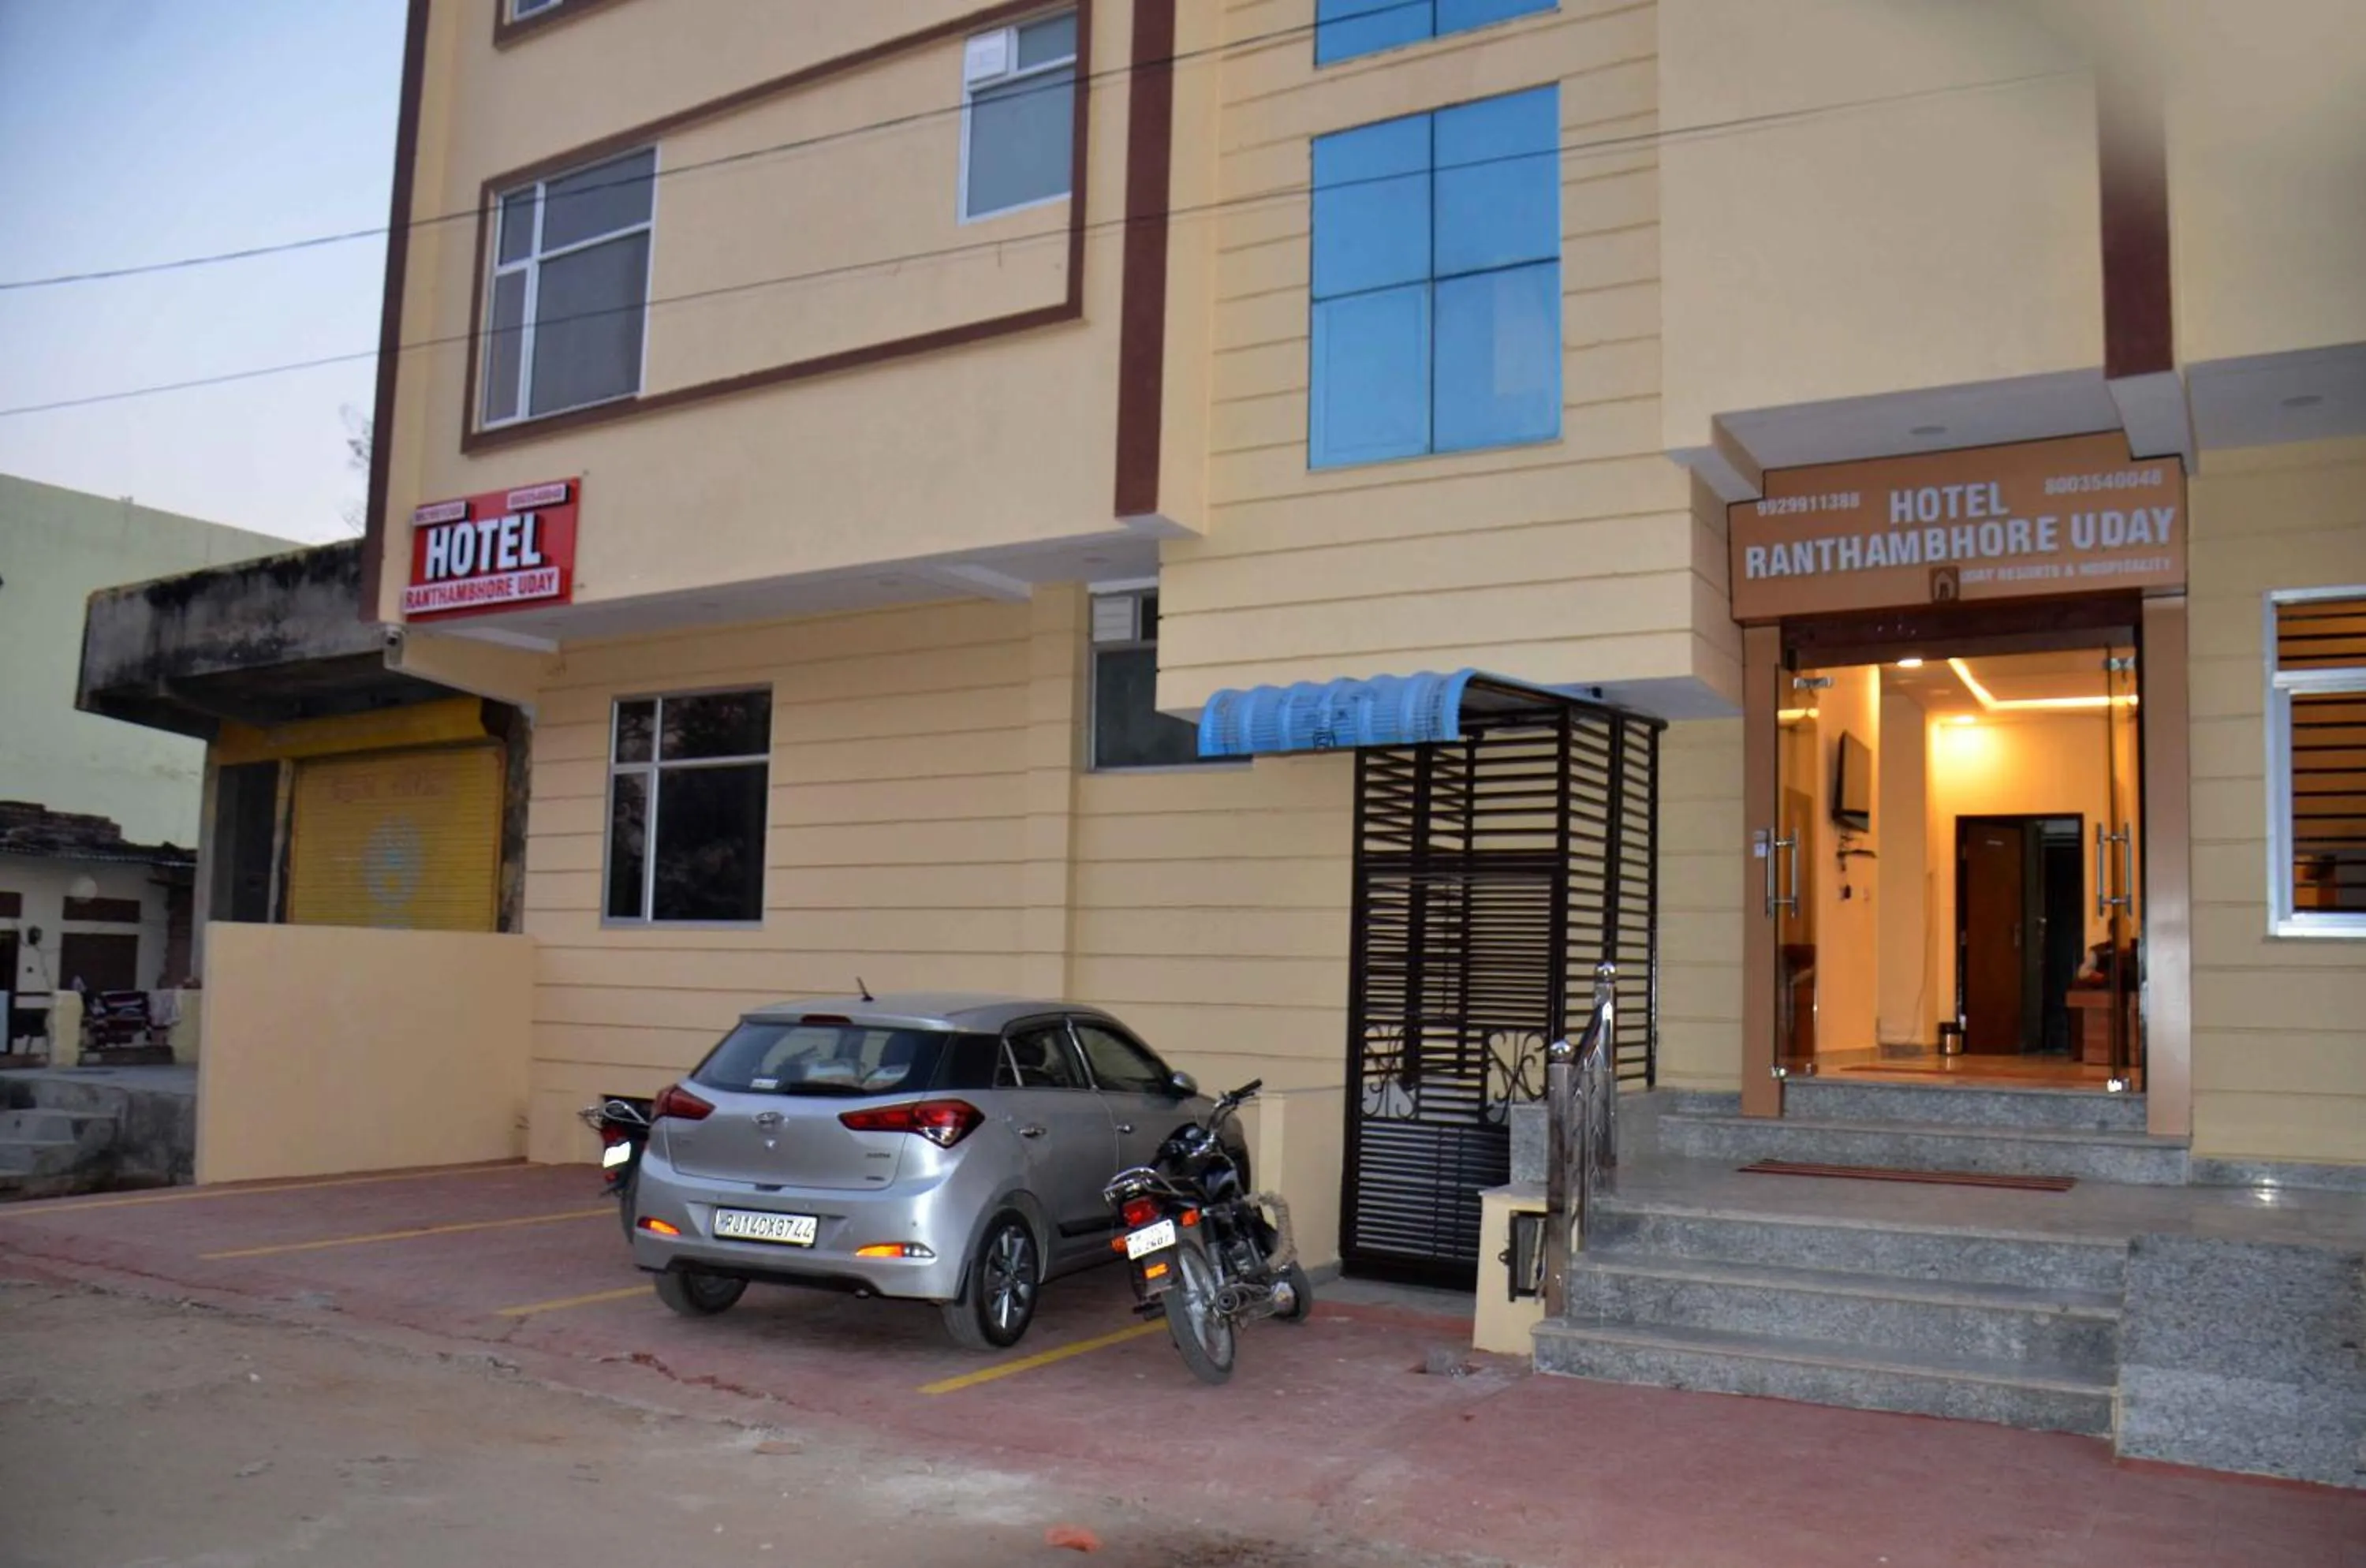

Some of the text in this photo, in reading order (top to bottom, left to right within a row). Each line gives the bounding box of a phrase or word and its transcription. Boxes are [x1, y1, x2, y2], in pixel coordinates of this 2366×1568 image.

[1890, 481, 2010, 525] HOTEL
[424, 512, 542, 581] HOTEL
[1745, 506, 2176, 580] RANTHAMBHORE UDAY
[517, 570, 555, 595] UDAY
